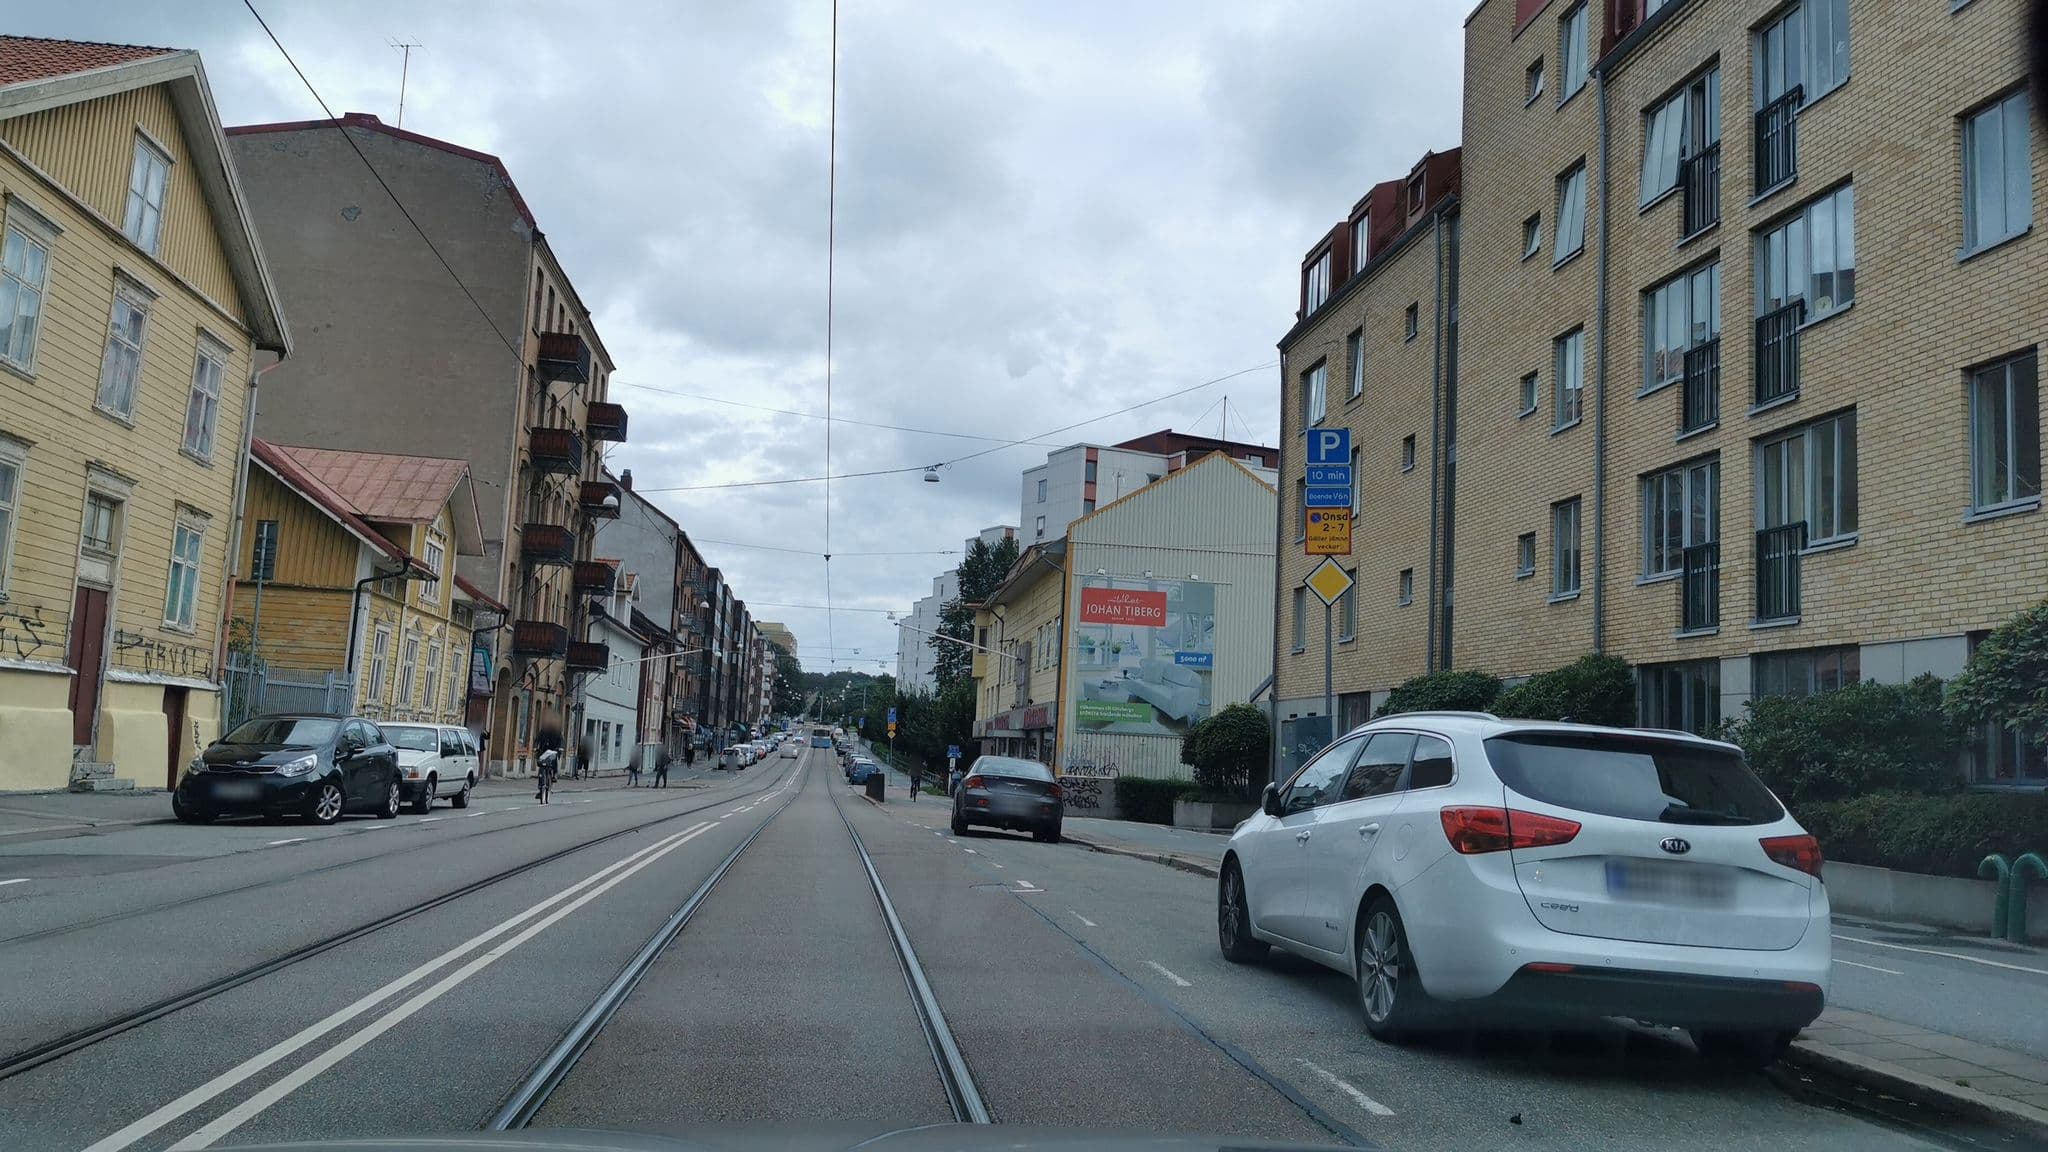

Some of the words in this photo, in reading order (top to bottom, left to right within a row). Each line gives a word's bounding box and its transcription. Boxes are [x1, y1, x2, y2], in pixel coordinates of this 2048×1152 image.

[1320, 431, 1341, 461] P
[1312, 470, 1324, 480] 10
[1327, 470, 1345, 480] min
[1322, 512, 1348, 521] Onsd
[1086, 603, 1121, 616] JOHAN
[1124, 605, 1161, 618] TIBERG
[1664, 840, 1687, 852] KIA
